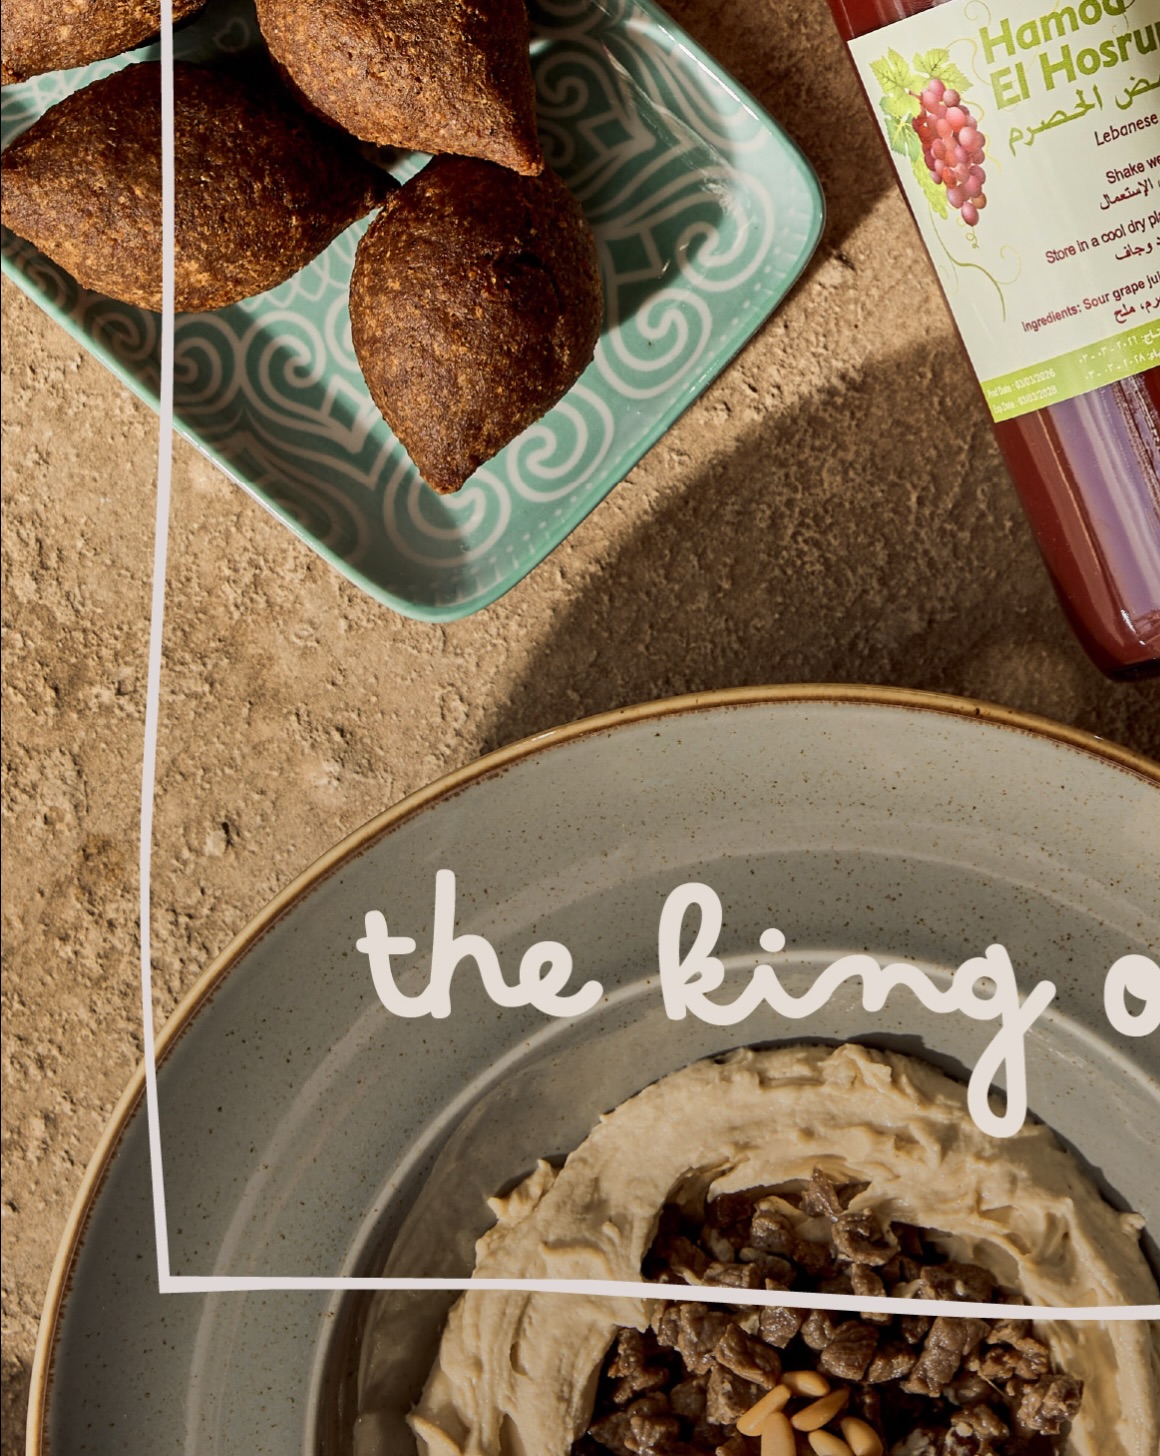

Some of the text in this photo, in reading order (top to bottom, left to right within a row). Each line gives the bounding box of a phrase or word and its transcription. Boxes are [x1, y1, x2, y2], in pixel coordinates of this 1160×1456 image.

[990, 62, 1031, 111] El
[1009, 84, 1103, 157] الحصرم
[1094, 113, 1159, 146] Lebanese
[1106, 162, 1145, 184] Shake
[1045, 245, 1077, 264] Store
[1076, 239, 1090, 252] in
[1091, 237, 1100, 247] a
[1101, 224, 1127, 244] cool
[1127, 218, 1147, 234] dry
[1114, 243, 1153, 261] وجاف
[1021, 303, 1082, 333] Ingredients:
[1083, 293, 1110, 311] Sour
[1112, 280, 1145, 301] grape
[1113, 301, 1136, 324] ملح
